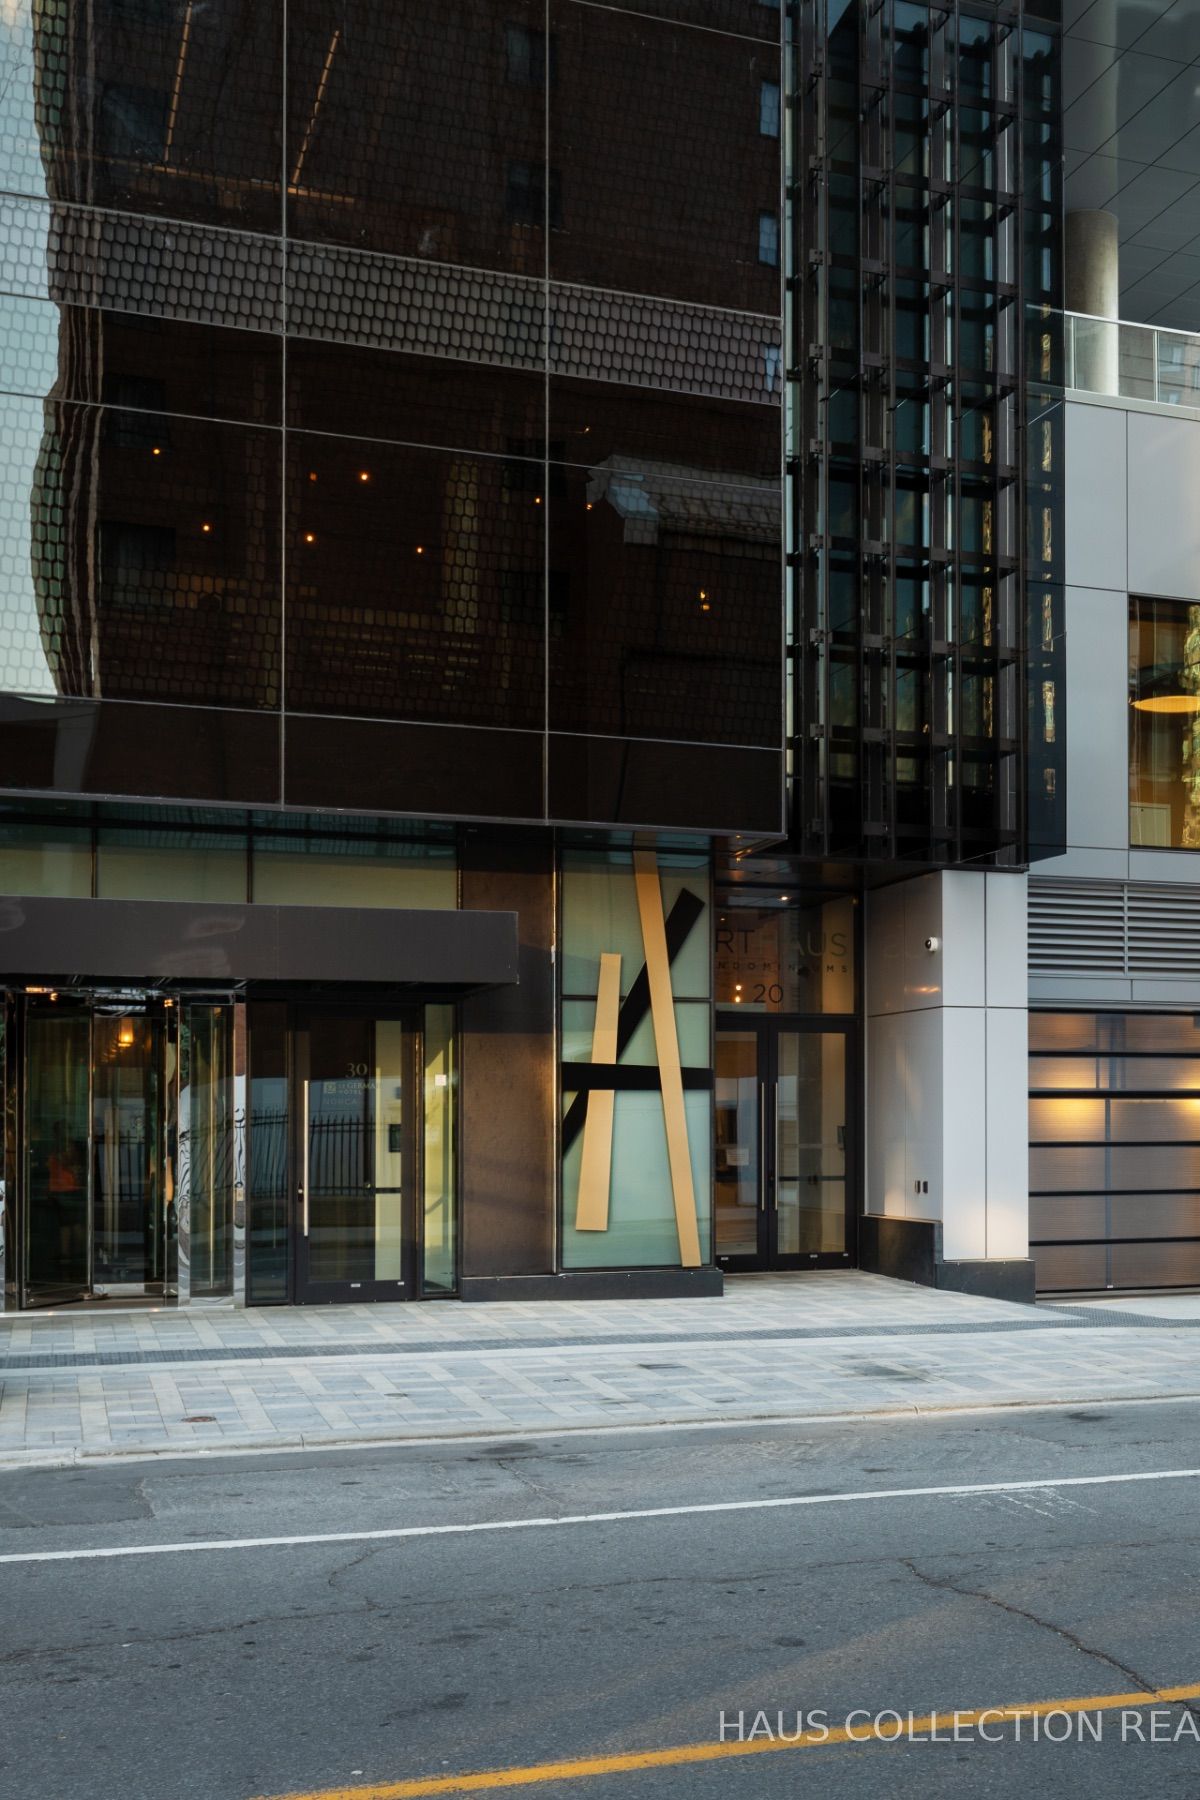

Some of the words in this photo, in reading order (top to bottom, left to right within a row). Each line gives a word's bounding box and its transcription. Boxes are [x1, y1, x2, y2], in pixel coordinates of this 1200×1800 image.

[715, 928, 755, 954] RT
[753, 983, 784, 1004] 20
[345, 1062, 368, 1078] 30
